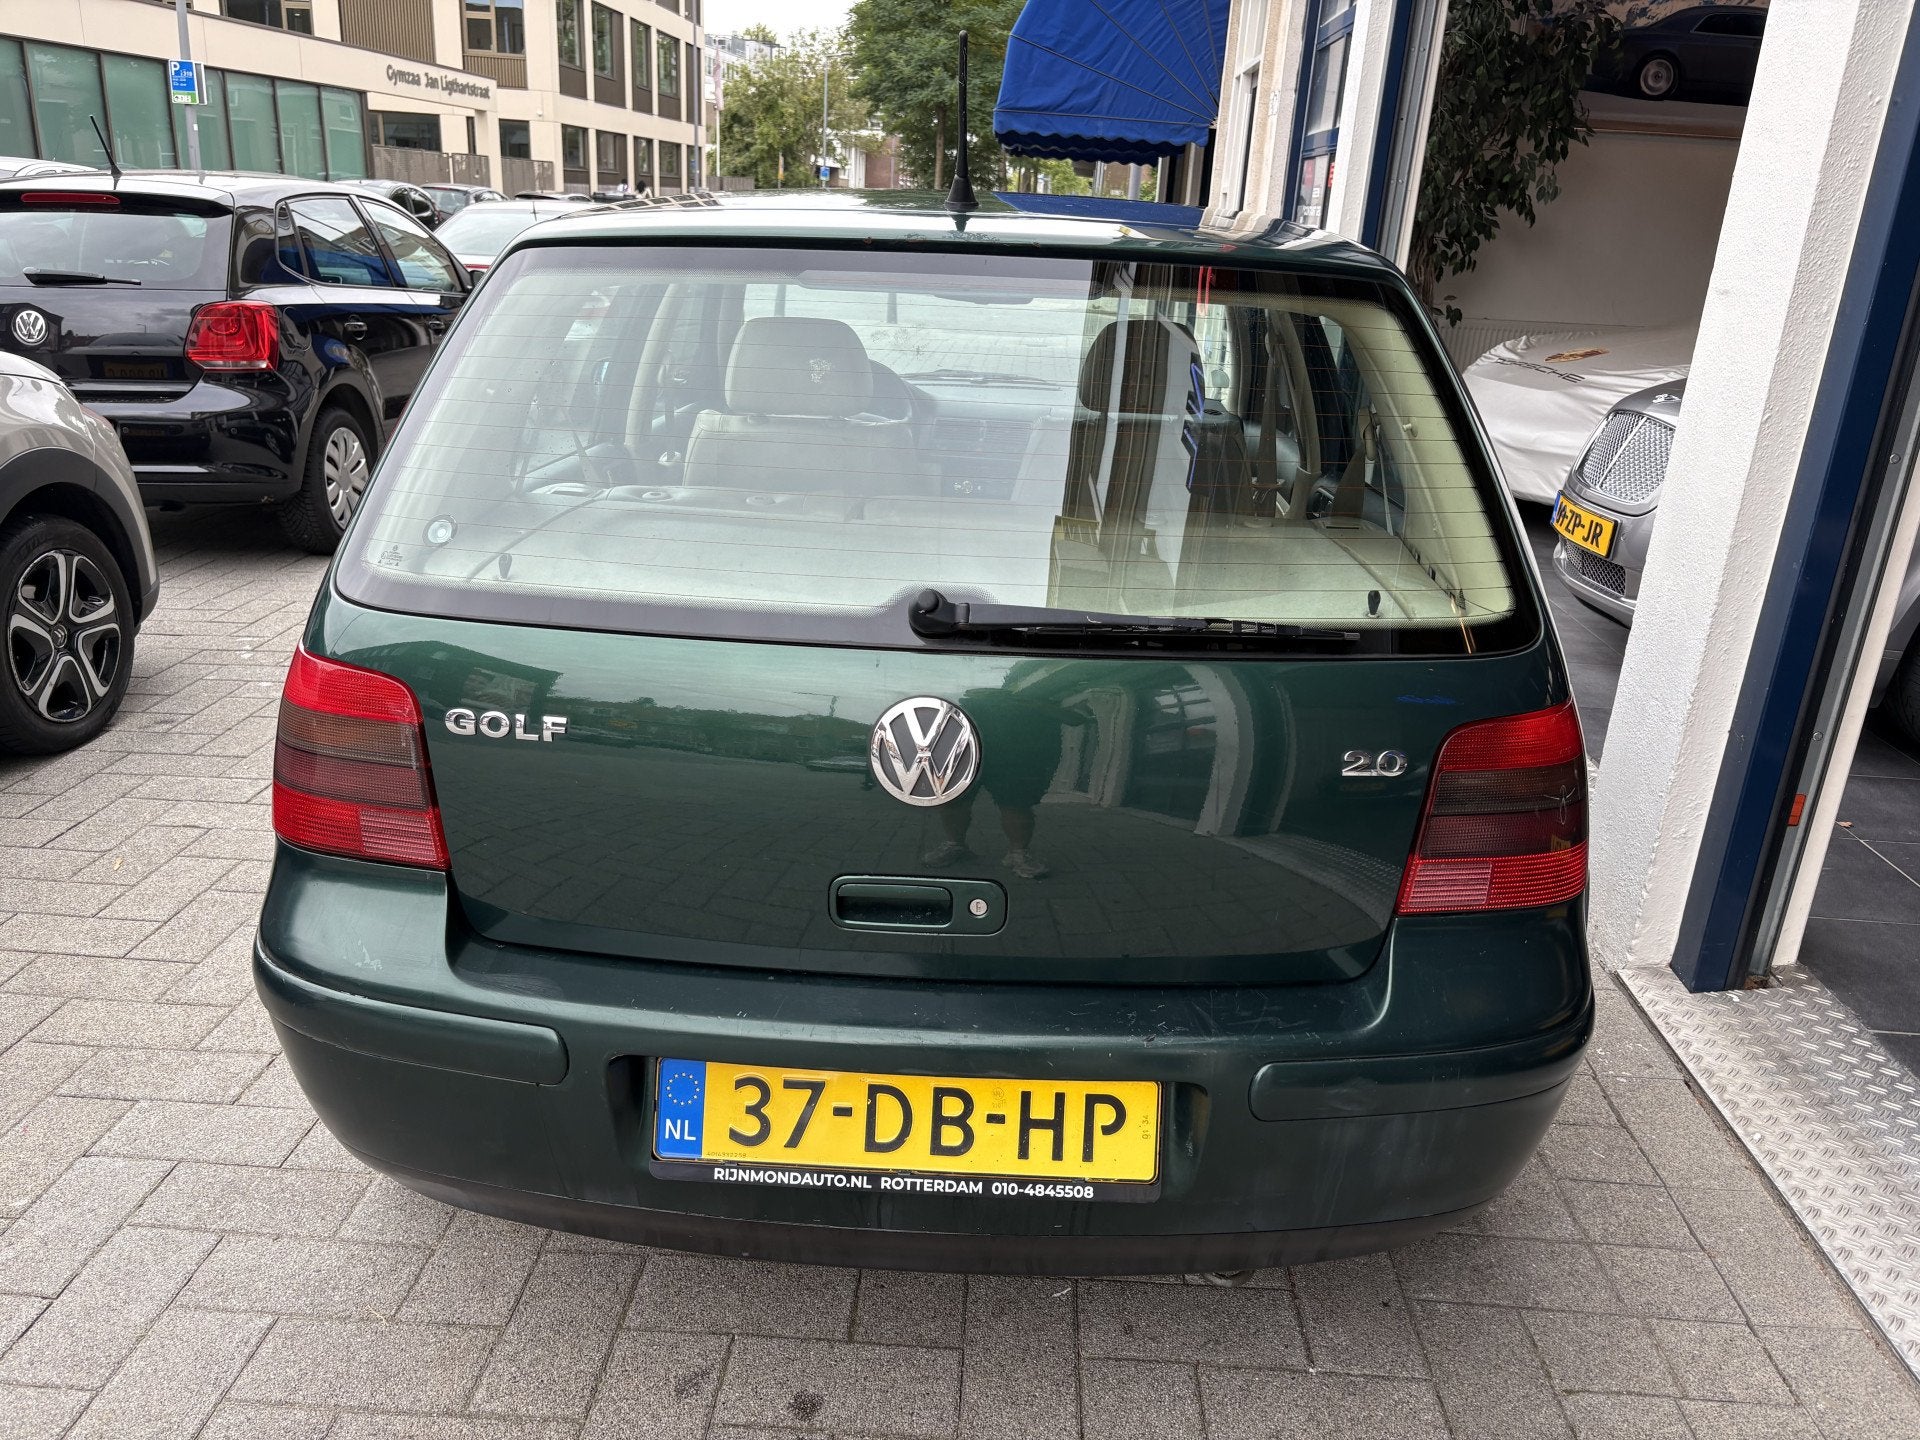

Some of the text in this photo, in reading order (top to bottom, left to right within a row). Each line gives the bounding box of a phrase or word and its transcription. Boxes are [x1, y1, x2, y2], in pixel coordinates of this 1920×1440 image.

[425, 72, 439, 89] Jan
[445, 708, 568, 742] GOLF
[665, 1118, 697, 1141] NL
[728, 1076, 1127, 1163] 37-DB-HP
[713, 1167, 1094, 1199] RIJNMONDAUTO.NL ROTTERDAM 010-4845508
